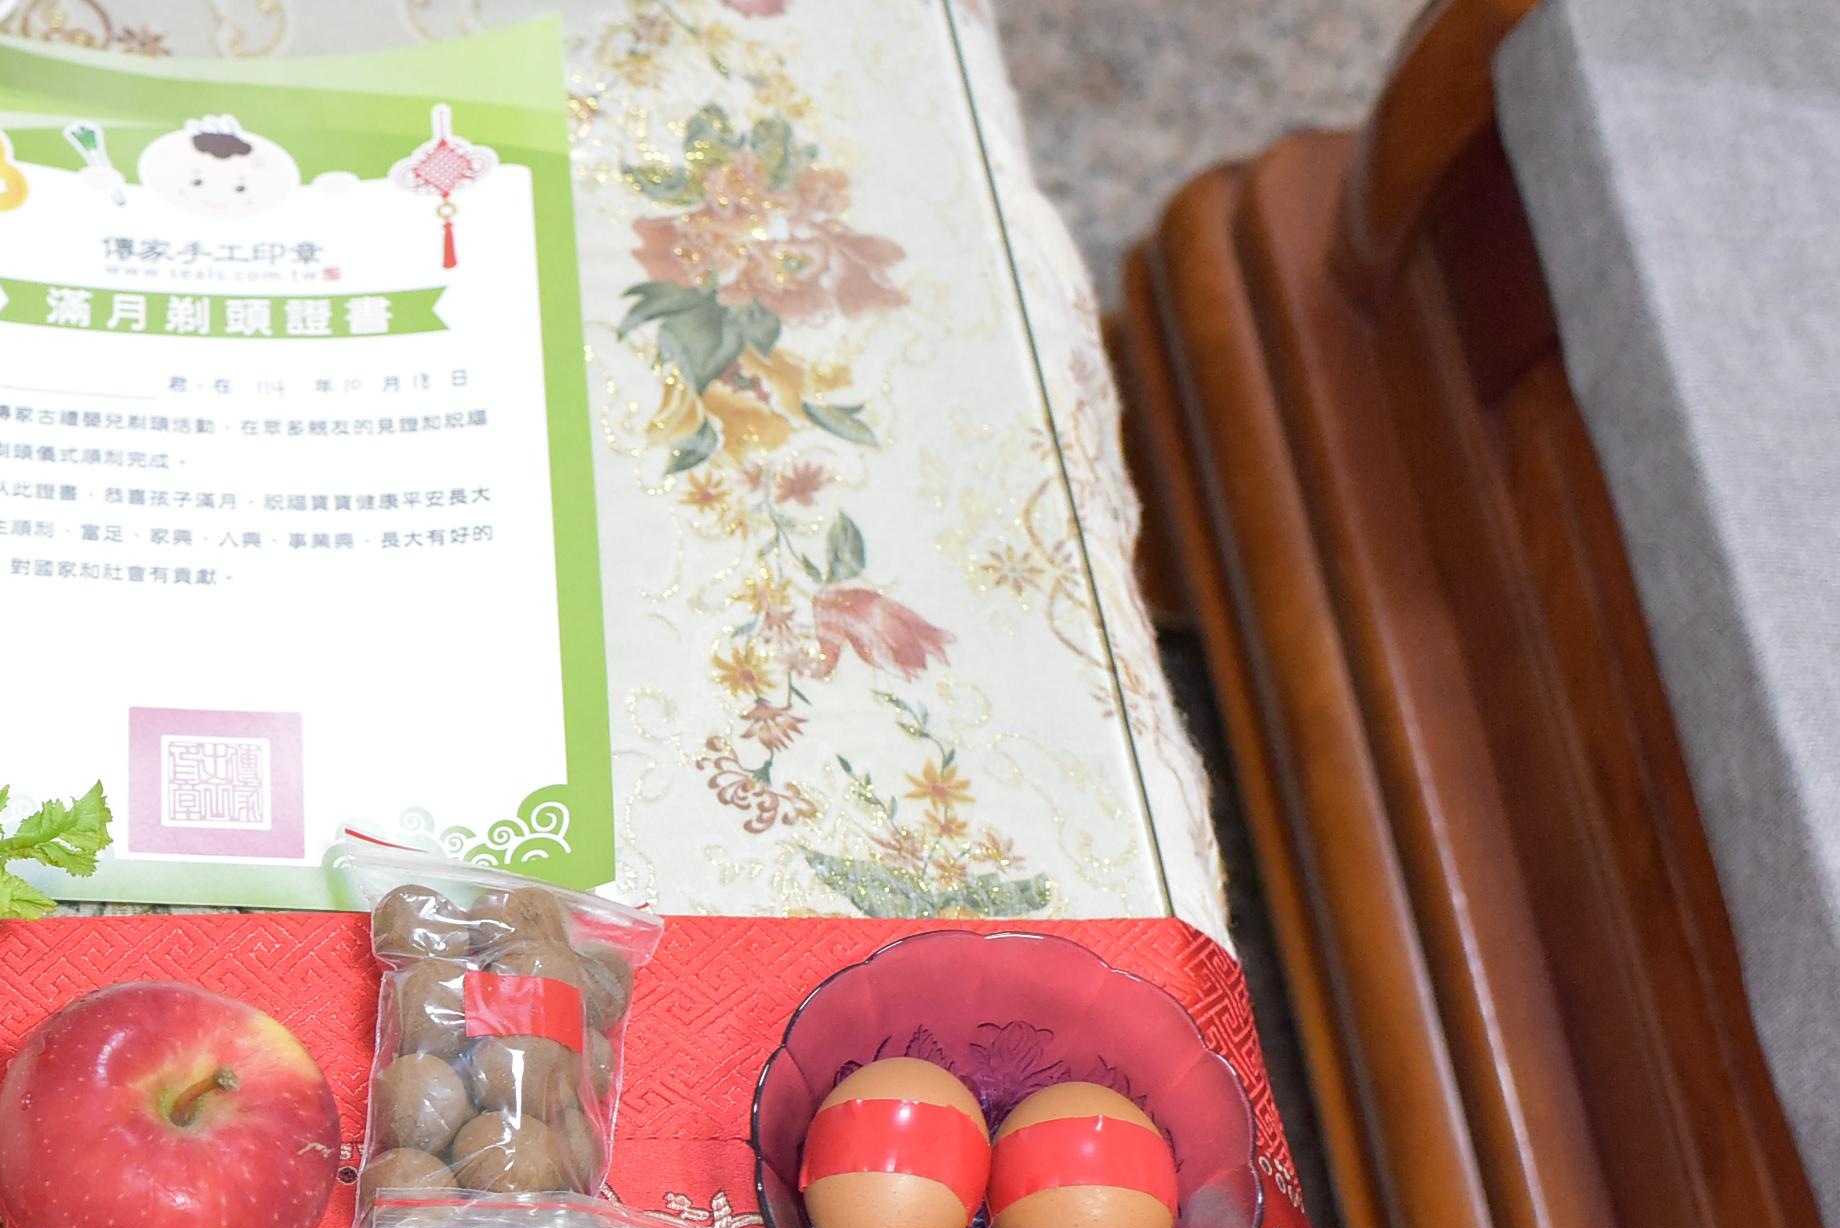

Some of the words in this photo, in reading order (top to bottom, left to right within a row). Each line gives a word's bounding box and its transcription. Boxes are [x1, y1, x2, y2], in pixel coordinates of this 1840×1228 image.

[102, 236, 323, 264] 傳家手工印章
[46, 286, 394, 337] 滿月剃頭證書
